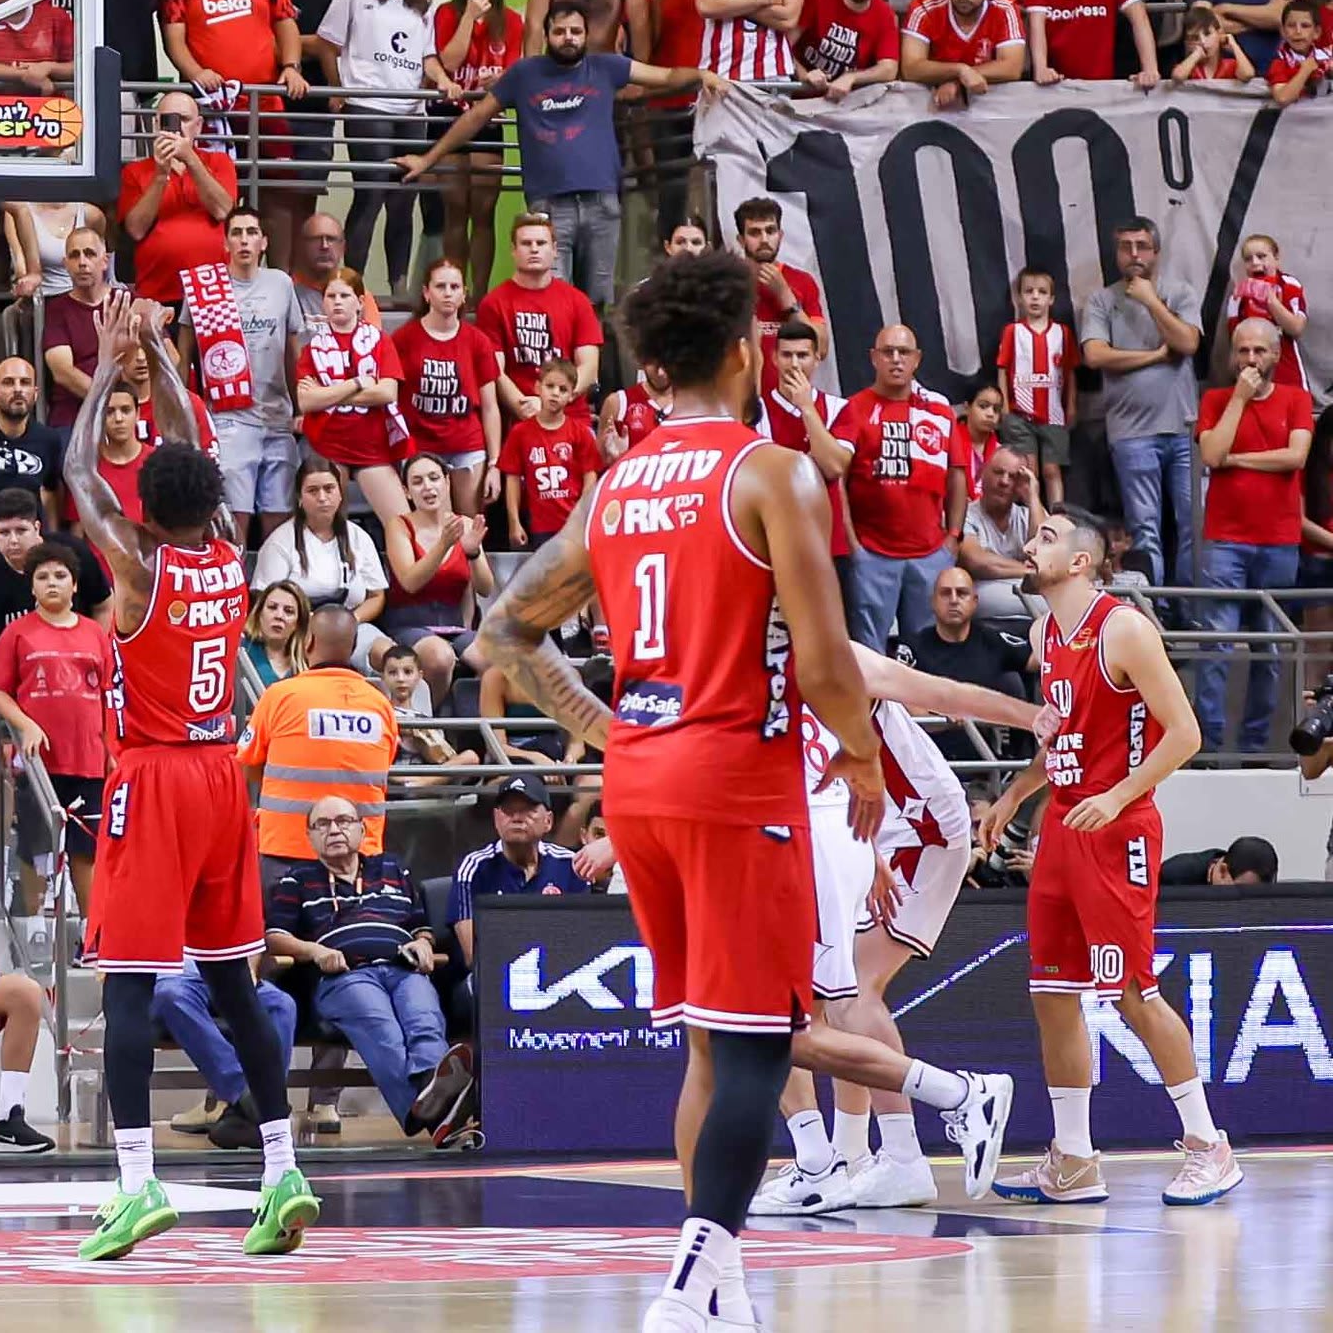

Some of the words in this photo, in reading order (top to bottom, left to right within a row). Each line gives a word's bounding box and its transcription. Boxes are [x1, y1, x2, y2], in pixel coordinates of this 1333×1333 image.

[827, 21, 859, 47] אהבה
[373, 51, 423, 73] congstar
[32, 119, 60, 138] סל
[516, 312, 547, 330] אהבה
[422, 359, 456, 377] אהבה
[420, 378, 459, 396] לעולם
[451, 396, 468, 415] לא
[529, 448, 546, 464] 41
[535, 465, 569, 491] SP
[609, 448, 723, 492] טוקוטו
[539, 487, 570, 500] metzer
[623, 496, 675, 534] RK
[166, 563, 246, 594] מנפורד
[188, 599, 226, 627] RK
[633, 553, 666, 661] 1
[187, 637, 227, 714] 5
[1050, 678, 1072, 719] 10
[317, 714, 372, 737] סדרן
[1128, 701, 1147, 769] HAPO
[1127, 836, 1148, 887] TLV
[1090, 944, 1124, 984] 10
[509, 1027, 627, 1050] Movement
